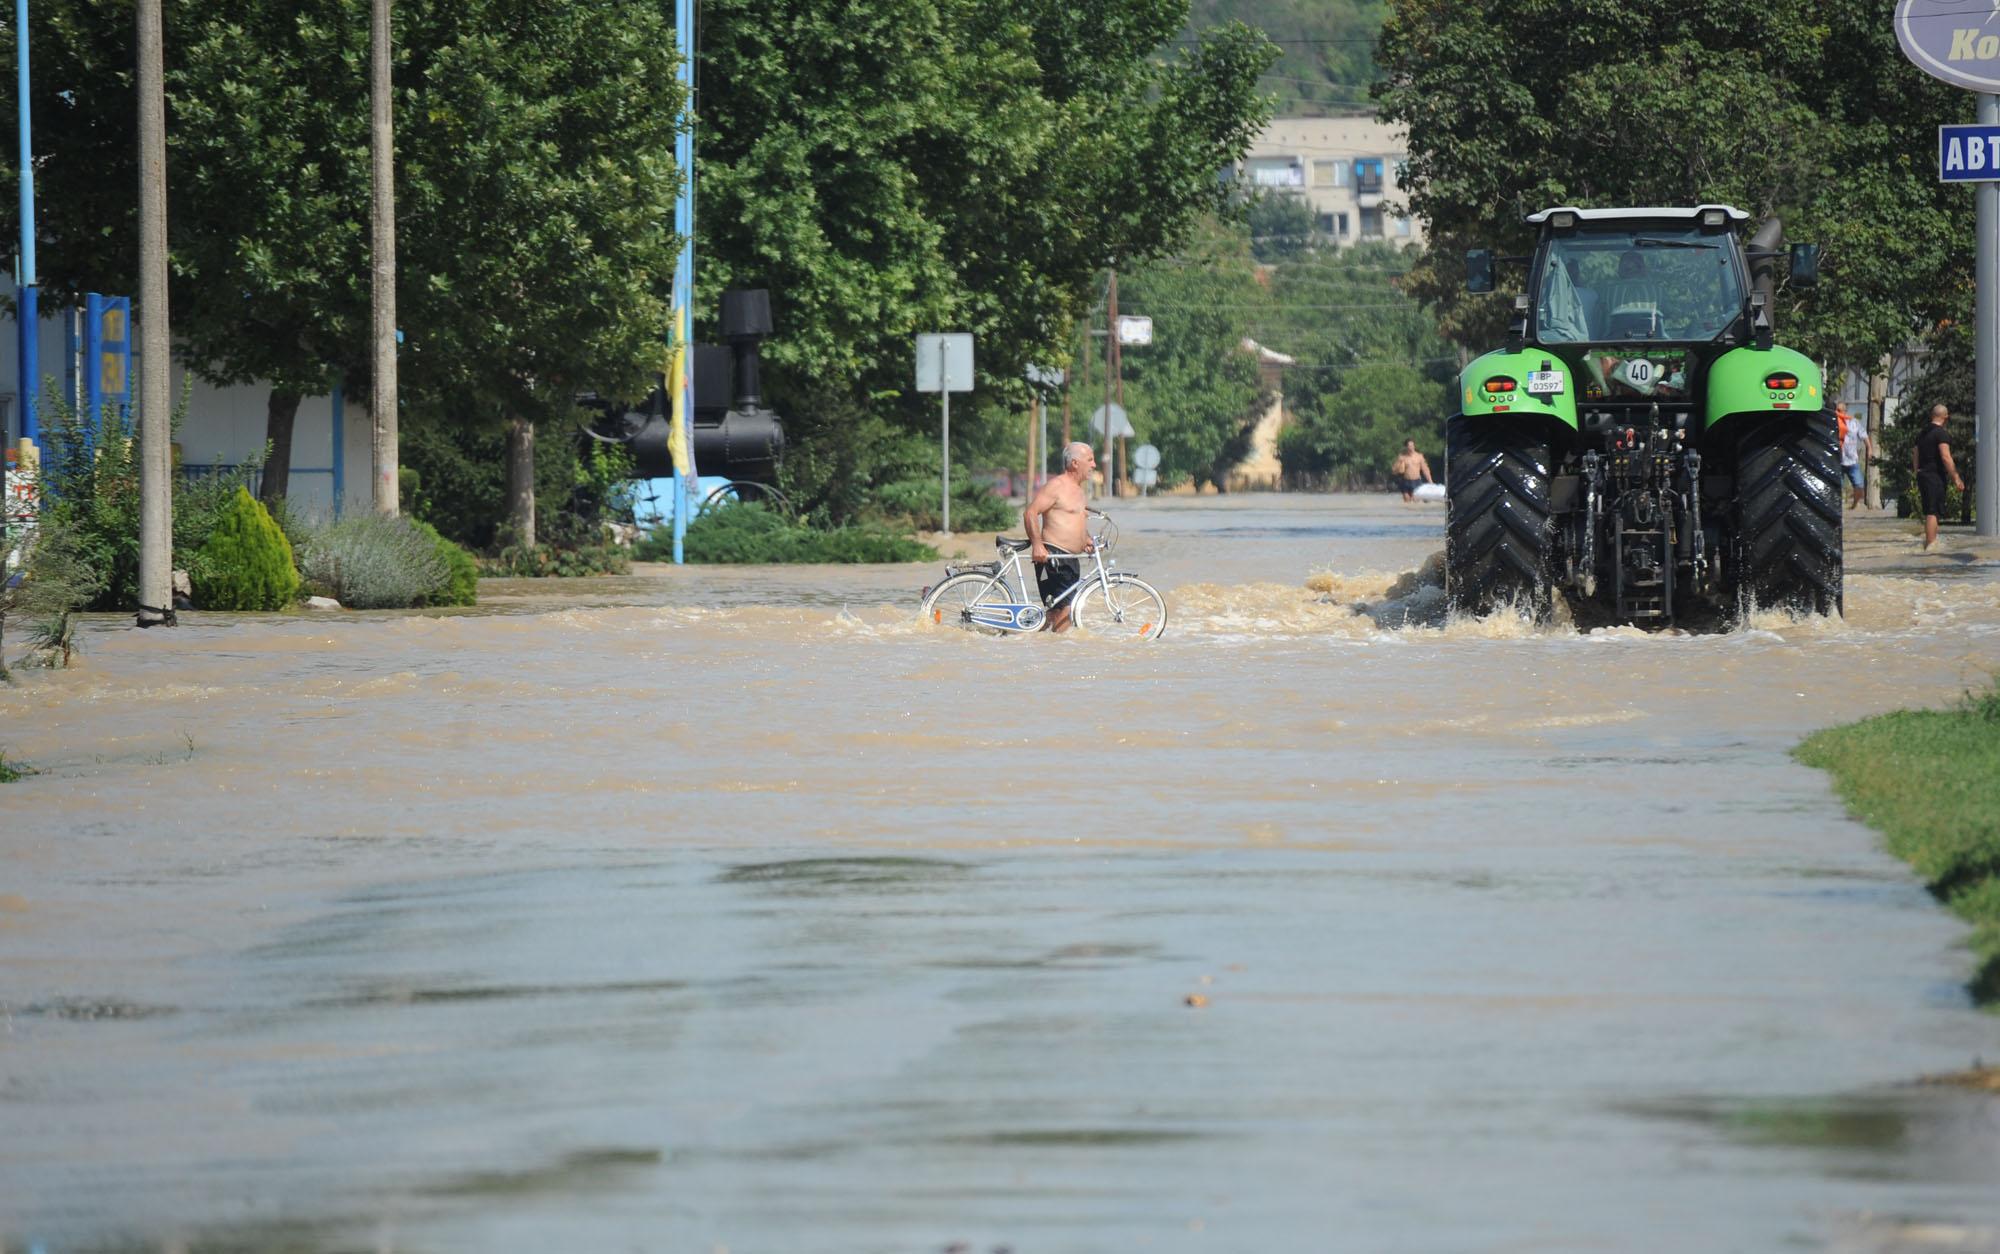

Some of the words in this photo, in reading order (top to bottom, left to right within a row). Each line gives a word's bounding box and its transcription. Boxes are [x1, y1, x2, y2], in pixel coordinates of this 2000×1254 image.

[1948, 28, 2000, 61] Ко
[1631, 364, 1648, 381] 40
[1533, 382, 1559, 391] 03597
